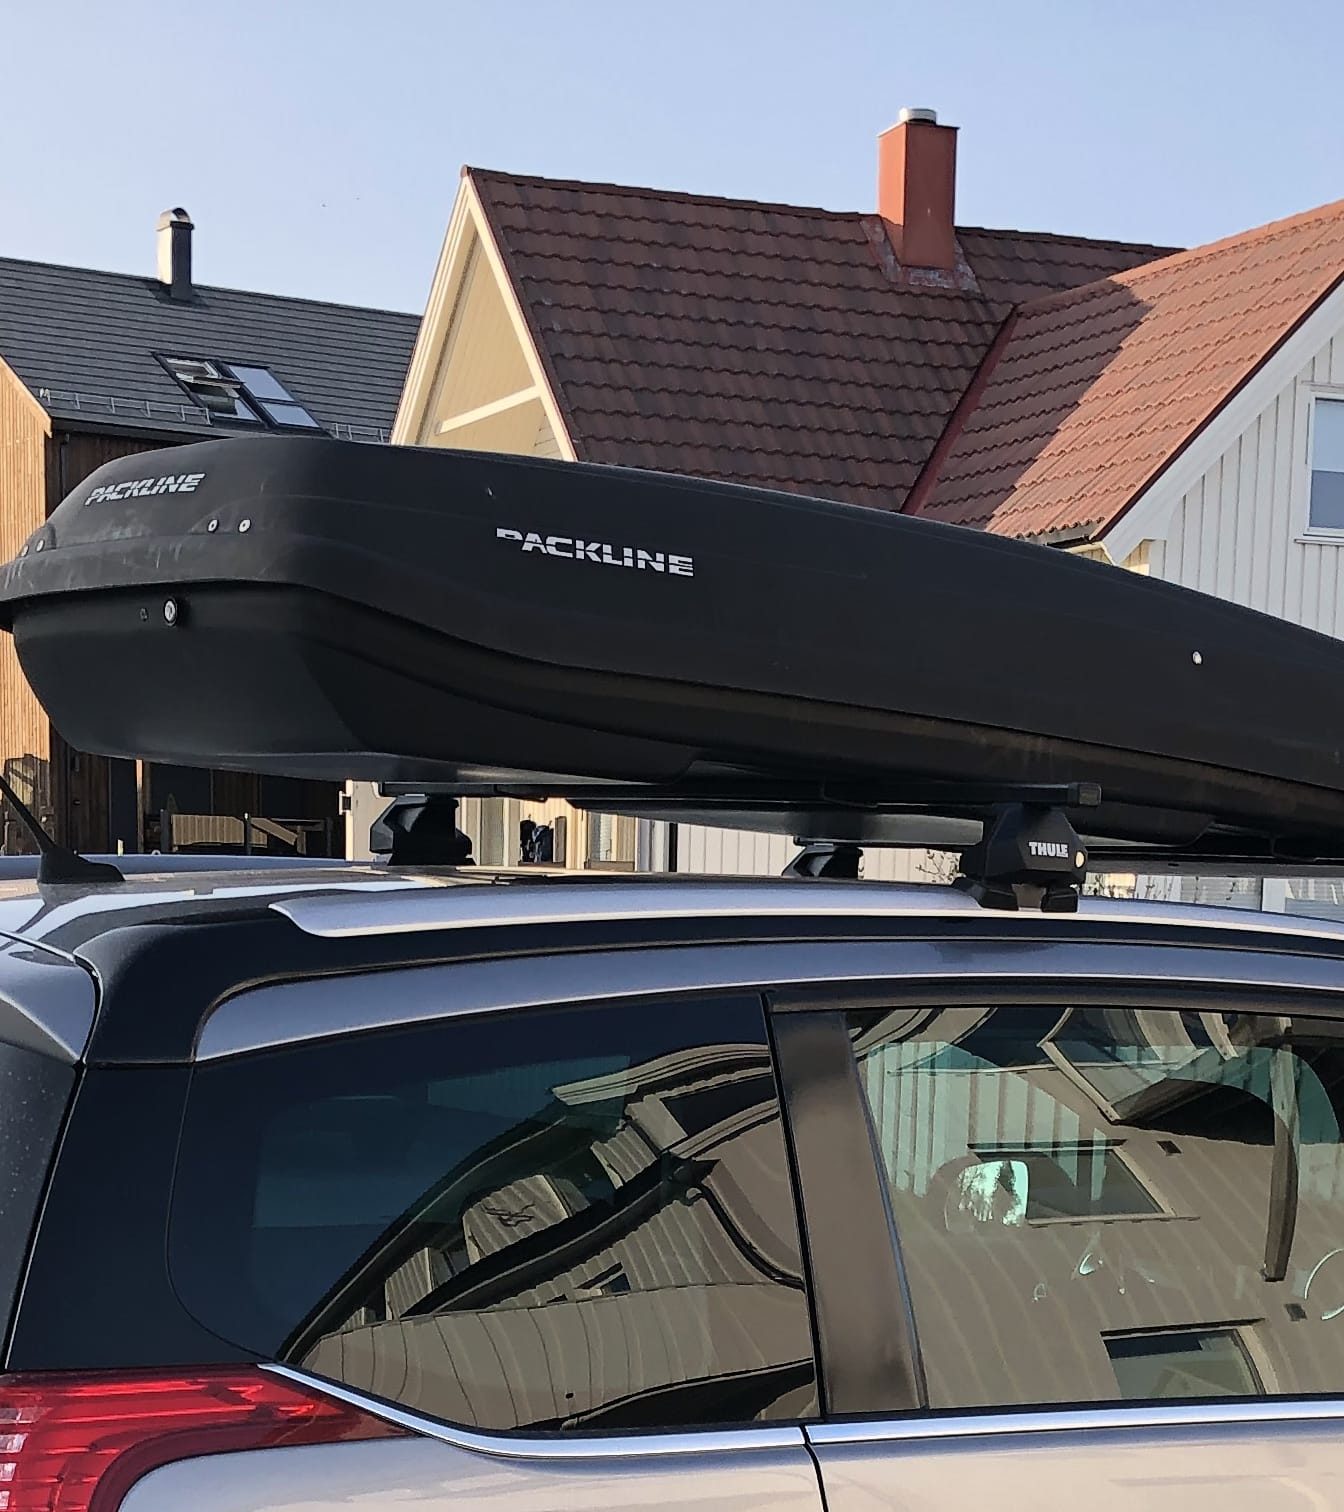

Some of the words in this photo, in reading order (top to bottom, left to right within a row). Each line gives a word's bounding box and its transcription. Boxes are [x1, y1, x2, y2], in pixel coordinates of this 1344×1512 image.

[84, 473, 205, 506] PACKLINE
[496, 527, 694, 577] PACKLINE
[1029, 841, 1069, 858] THULE
